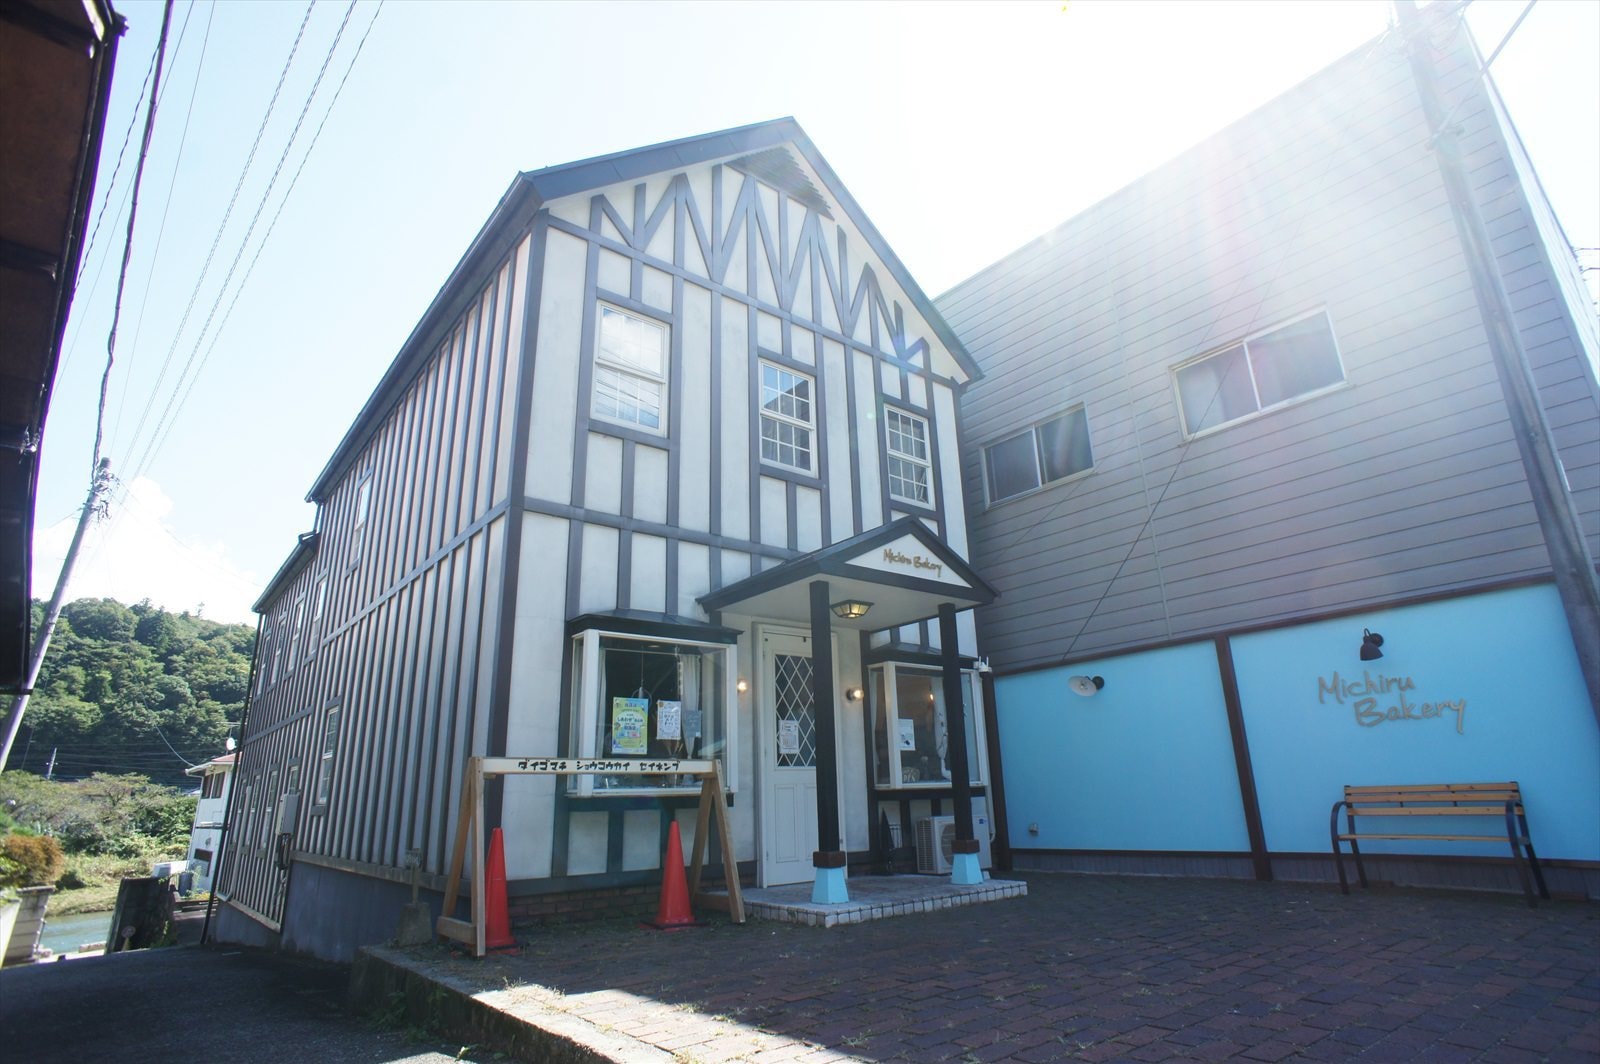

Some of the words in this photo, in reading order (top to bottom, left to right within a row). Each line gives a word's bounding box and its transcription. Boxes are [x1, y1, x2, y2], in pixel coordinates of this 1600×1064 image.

[913, 556, 942, 577] Bakery
[1318, 671, 1415, 704] Michiru
[1354, 693, 1465, 735] Bakery
[518, 758, 567, 771] ダイゴマチ
[576, 760, 630, 770] ショウコウカイ
[639, 760, 681, 771] セイネンブ
